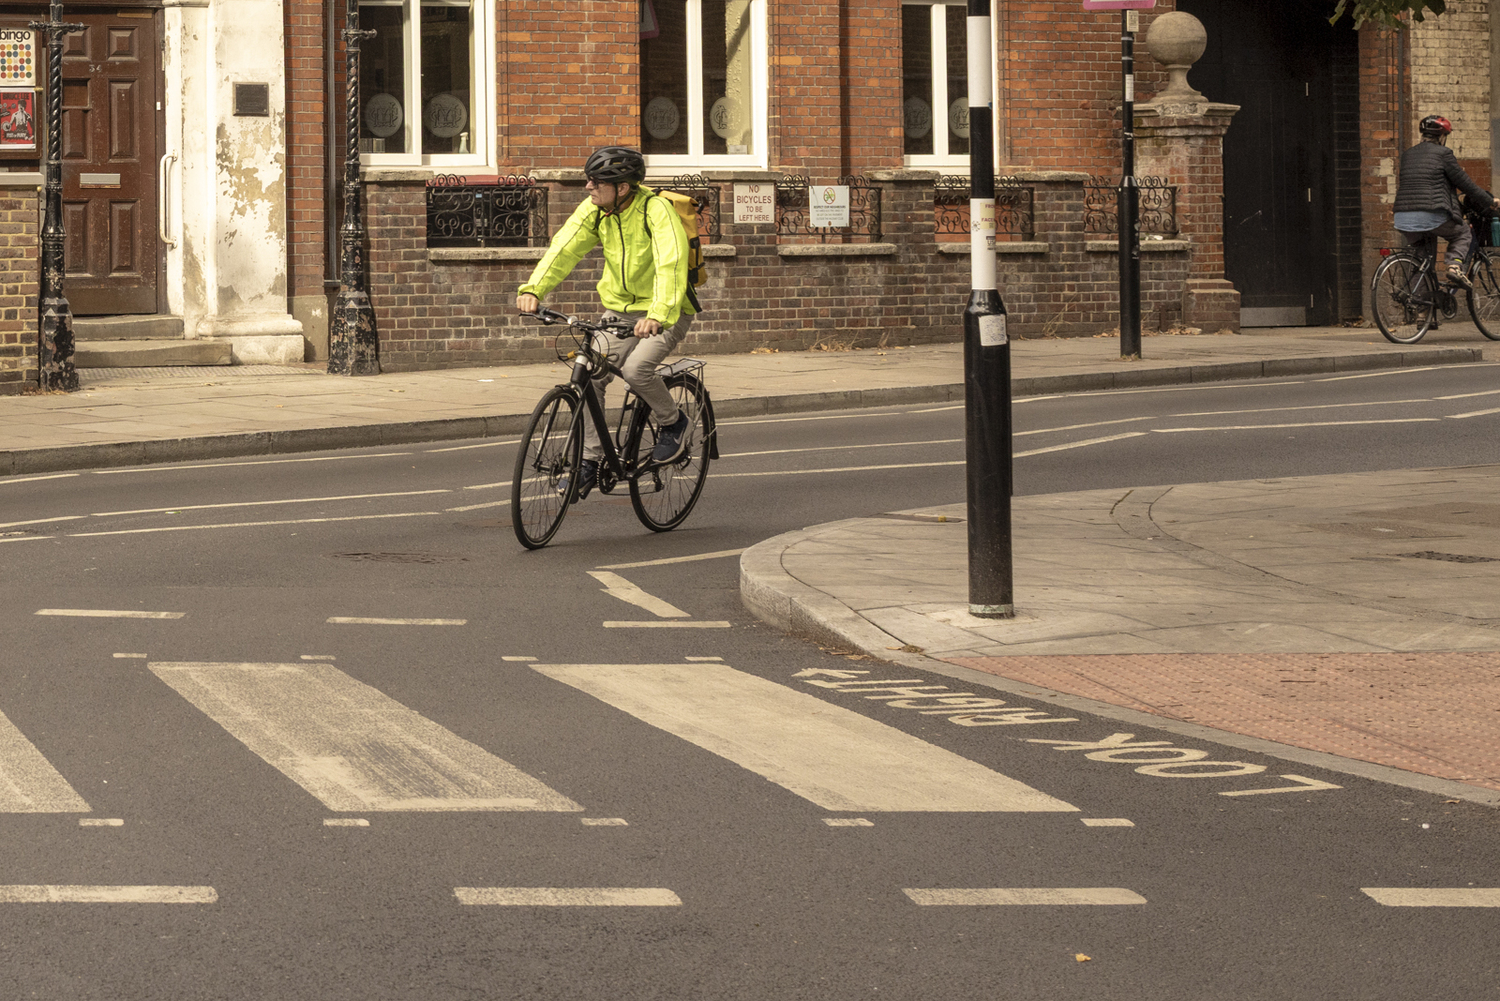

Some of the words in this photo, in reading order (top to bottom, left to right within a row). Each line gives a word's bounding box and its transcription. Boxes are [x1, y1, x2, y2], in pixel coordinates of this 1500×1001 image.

[0, 28, 31, 42] bingo
[748, 185, 760, 193] NO
[736, 195, 772, 204] BICYCLES
[739, 214, 753, 222] LEFT
[754, 214, 770, 222] HERE
[808, 679, 1080, 727] RIGHT
[1016, 733, 1344, 797] LOOK
